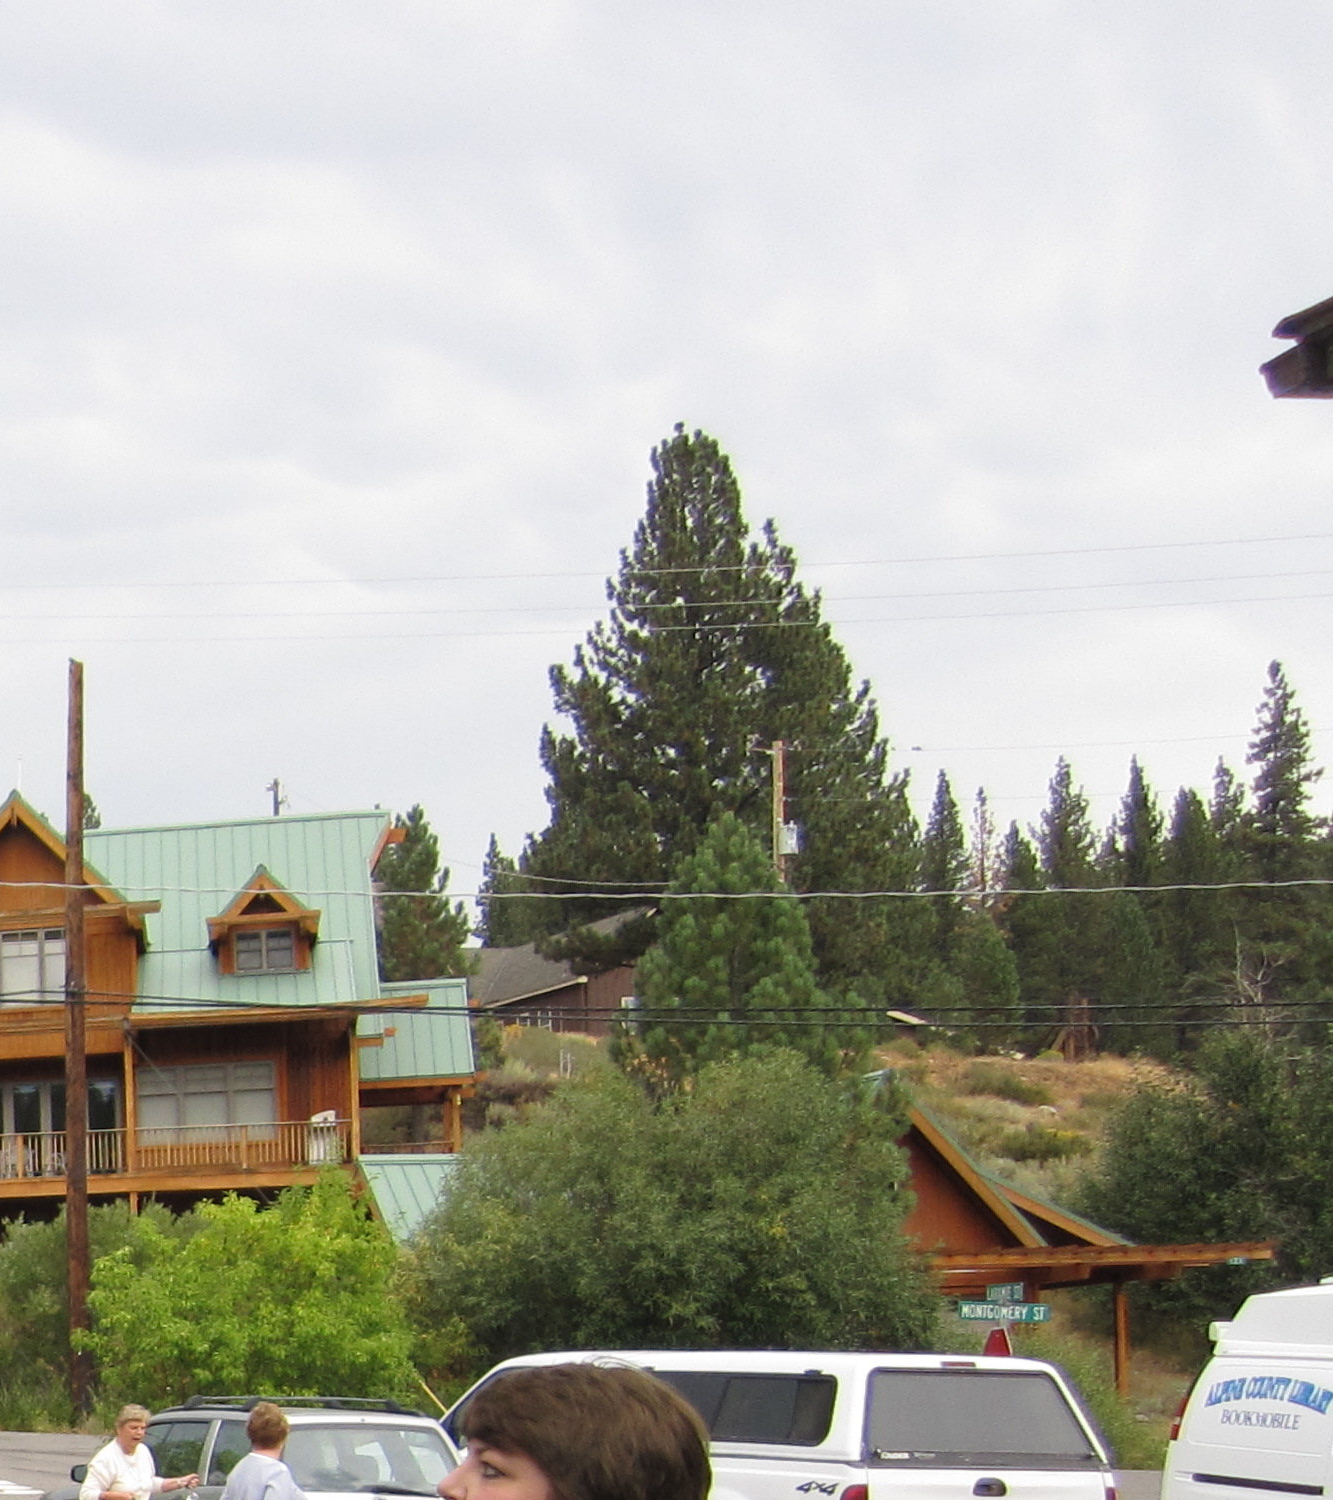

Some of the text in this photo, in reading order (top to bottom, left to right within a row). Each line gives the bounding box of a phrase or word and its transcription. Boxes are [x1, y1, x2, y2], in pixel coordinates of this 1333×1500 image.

[961, 1304, 1046, 1321] MONTGOMERY ST
[1220, 1409, 1302, 1431] BOOKMOBILE
